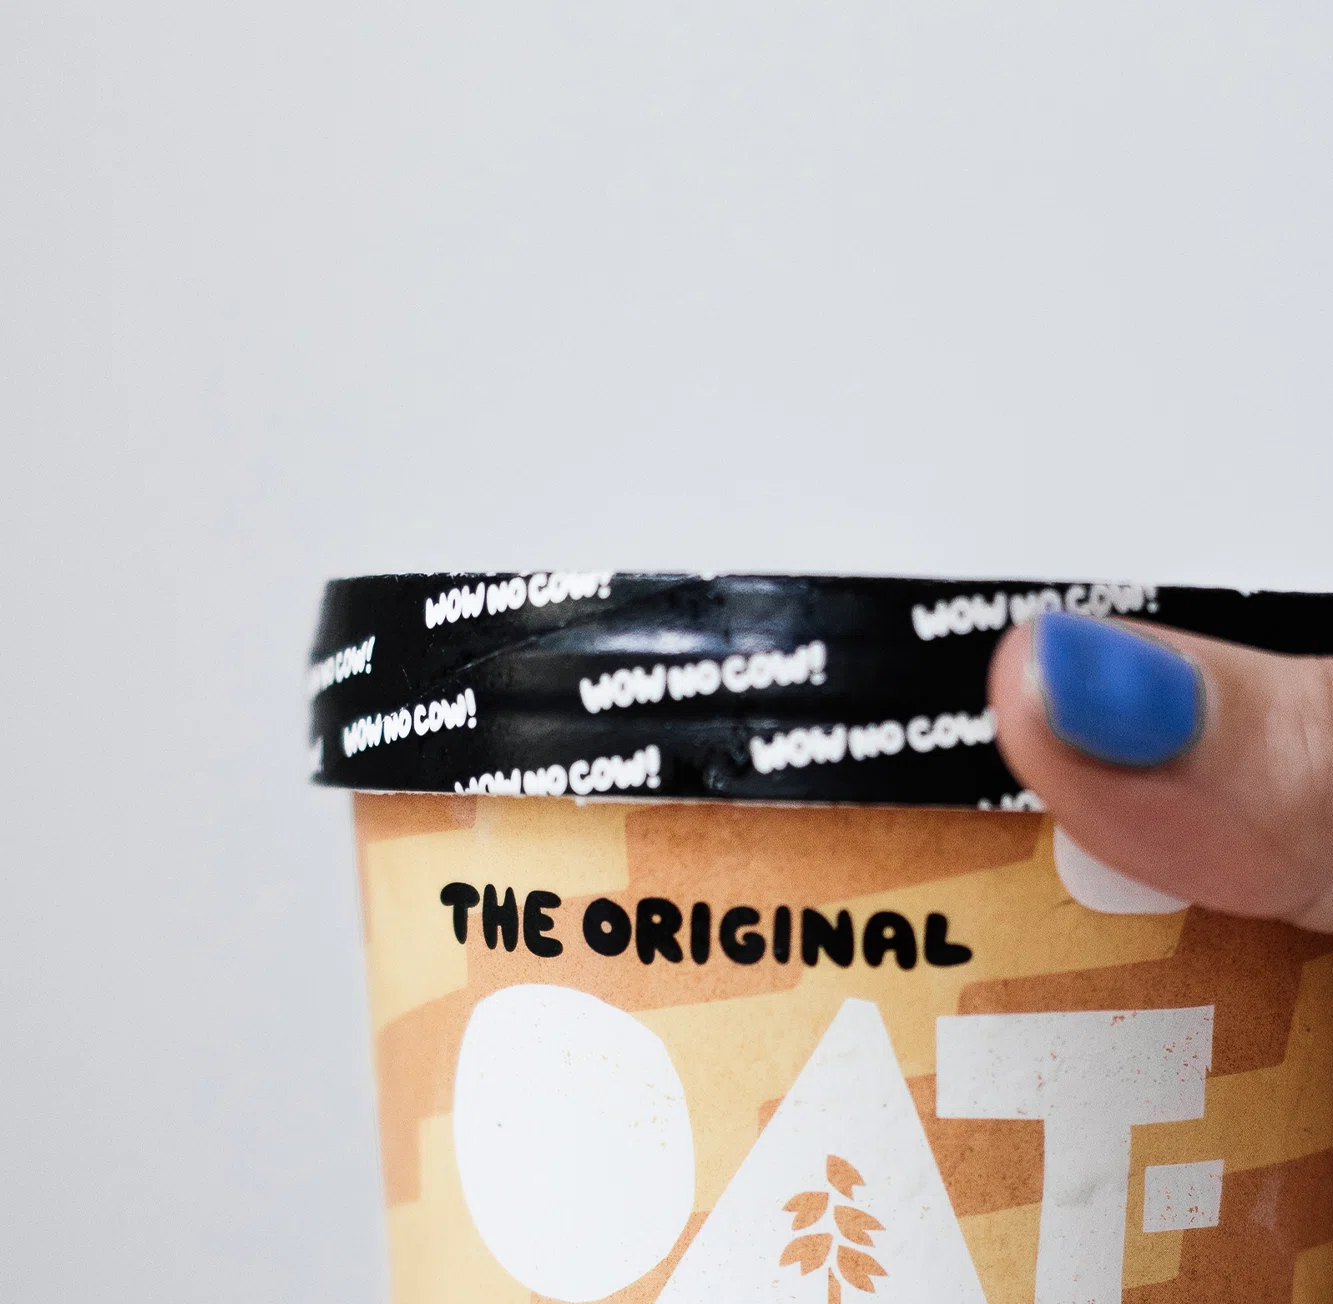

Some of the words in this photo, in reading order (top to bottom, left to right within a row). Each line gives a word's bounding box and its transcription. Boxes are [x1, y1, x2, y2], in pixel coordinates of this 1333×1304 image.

[425, 583, 485, 629] WOW
[486, 577, 527, 616] NO
[912, 595, 1008, 642] WOW
[335, 635, 376, 683] COW!
[579, 663, 667, 714] WOW
[667, 659, 721, 700] NO
[721, 640, 827, 693] COW!
[343, 713, 382, 757] WOW
[383, 708, 412, 744] NO
[413, 687, 477, 736] COW!
[750, 723, 847, 774] WOW
[847, 719, 905, 760] NO
[905, 706, 996, 753] COW
[522, 764, 568, 796] NO
[568, 745, 661, 795] COW!
[440, 881, 564, 957] THE
[582, 897, 974, 970] ORIGINAL
